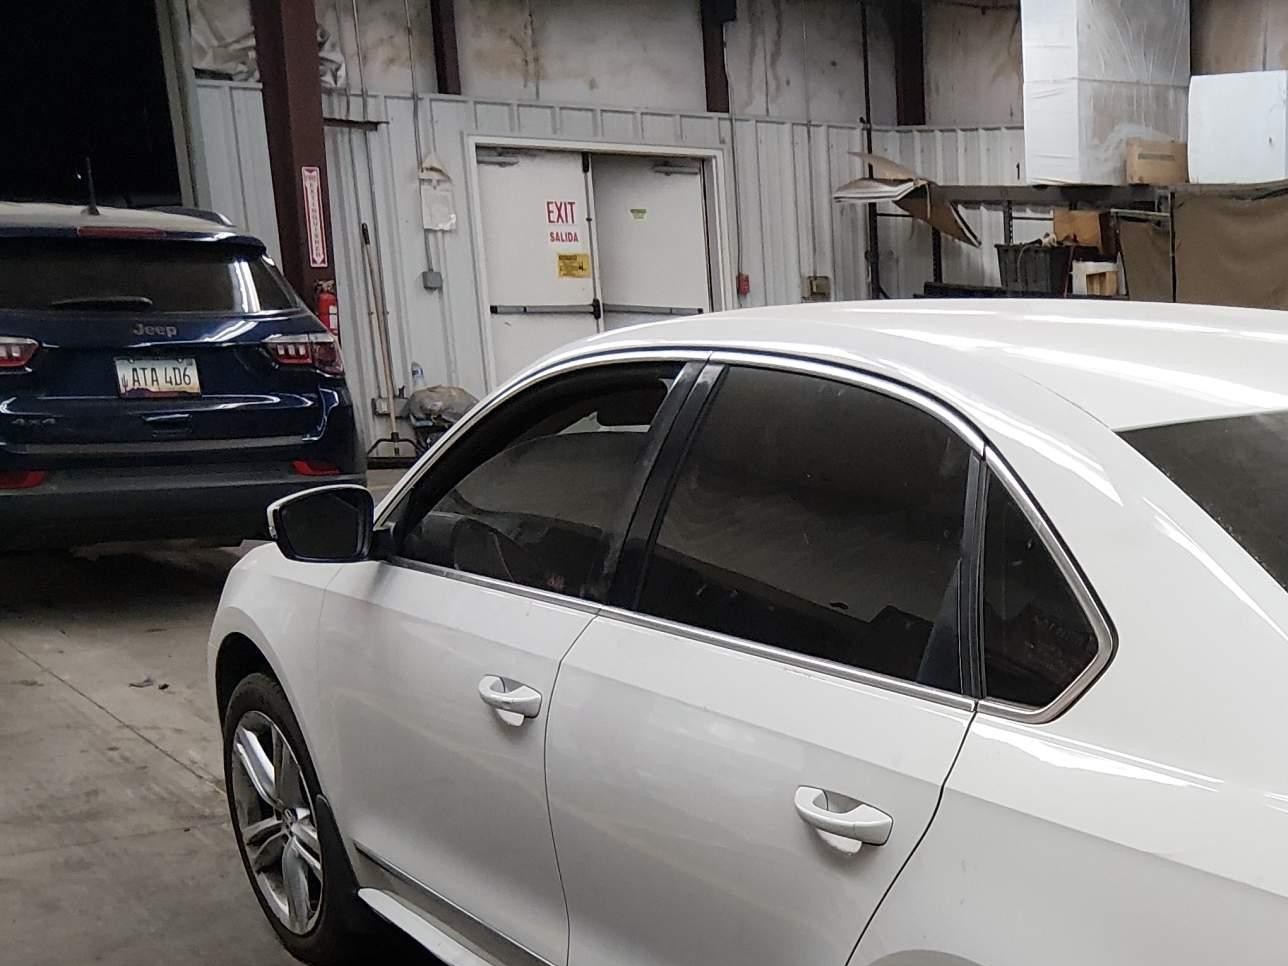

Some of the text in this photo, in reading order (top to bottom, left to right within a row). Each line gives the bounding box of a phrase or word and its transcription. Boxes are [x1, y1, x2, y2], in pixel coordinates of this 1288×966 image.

[546, 201, 576, 224] EXIT
[549, 231, 579, 243] SALIDA
[132, 323, 178, 338] Jeep
[131, 366, 192, 387] ATA 4D6
